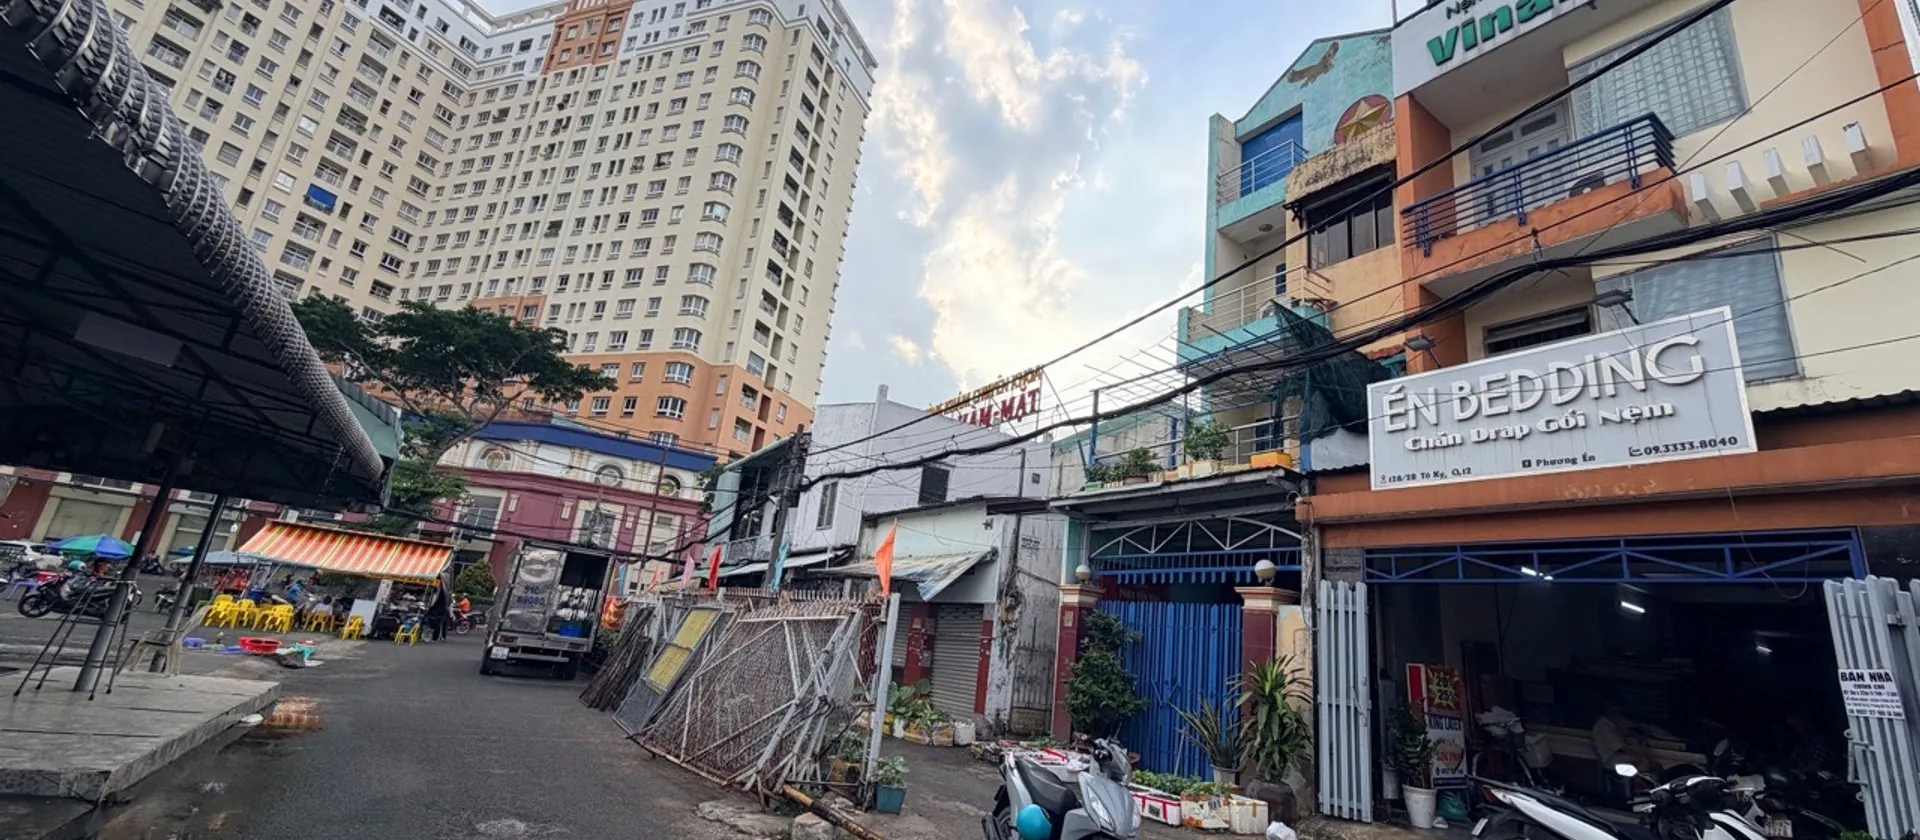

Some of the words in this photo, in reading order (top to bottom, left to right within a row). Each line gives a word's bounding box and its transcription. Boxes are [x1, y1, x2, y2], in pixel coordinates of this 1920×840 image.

[1383, 384, 1438, 433] ÉN
[1451, 335, 1705, 421] BEDDING
[1405, 431, 1463, 451] Chăn
[1470, 423, 1531, 443] Drap
[1536, 408, 1586, 433] Gối
[1600, 402, 1676, 425] Nệm
[1536, 457, 1578, 467] Phương
[1644, 436, 1738, 455] 09.3333.8040
